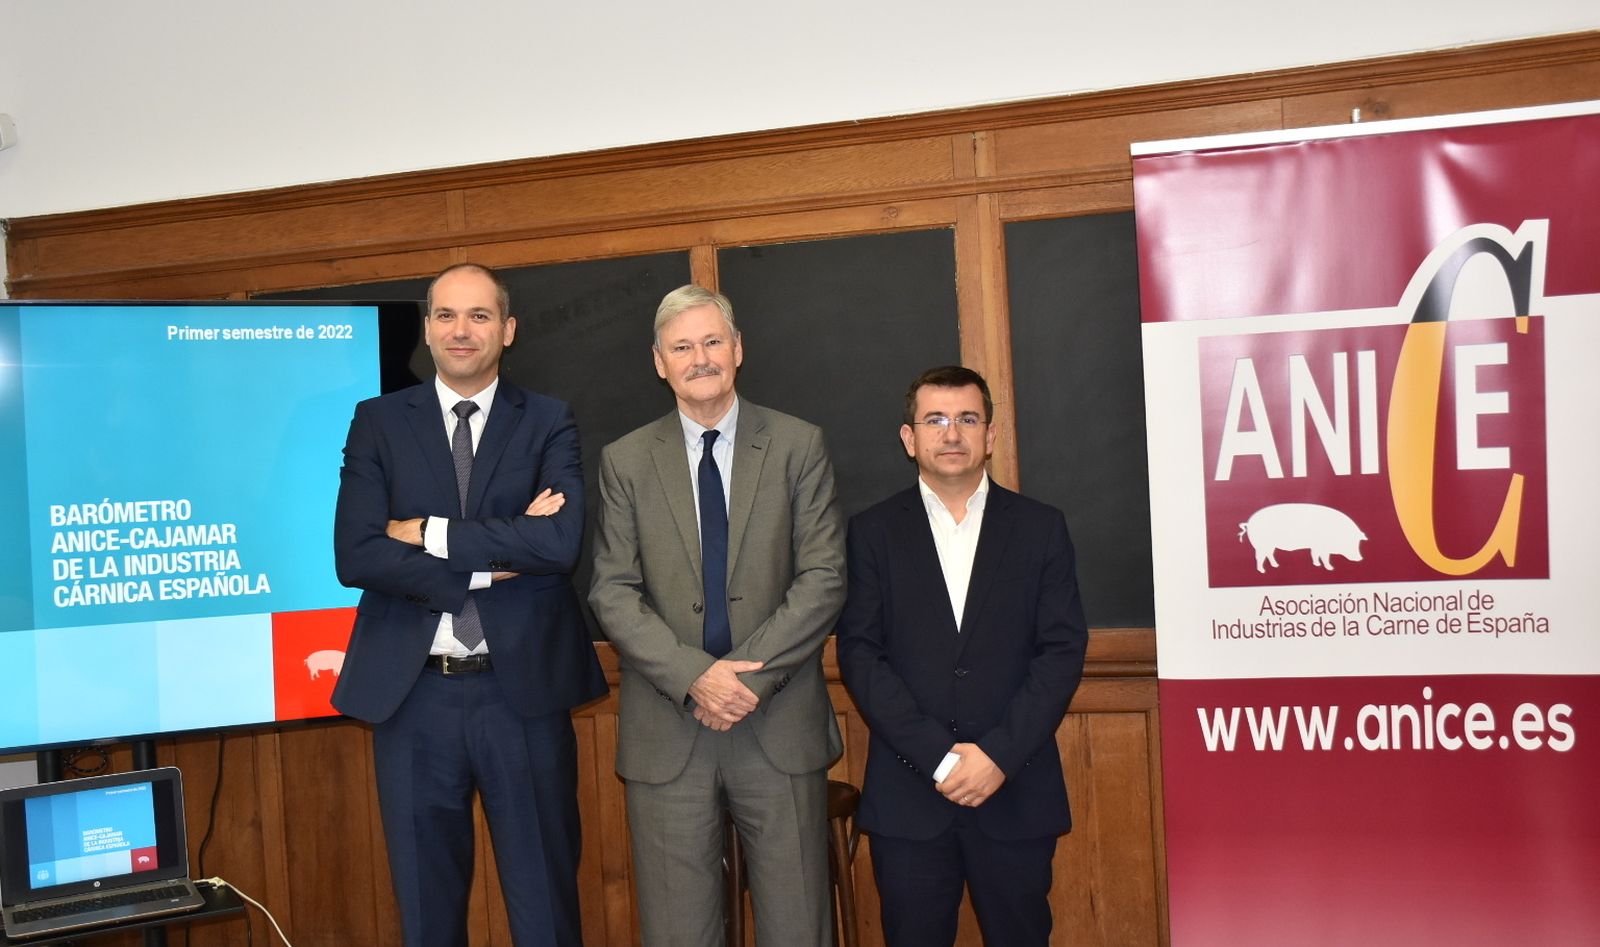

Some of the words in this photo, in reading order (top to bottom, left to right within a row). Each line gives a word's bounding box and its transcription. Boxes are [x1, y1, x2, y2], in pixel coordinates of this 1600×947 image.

[167, 325, 220, 341] Primer
[223, 325, 293, 340] semestre
[296, 325, 315, 340] de
[318, 324, 353, 340] 2022
[1215, 236, 1533, 576] ANICE
[50, 498, 192, 527] BARÓMETRO
[51, 523, 237, 553] ANICE-CAJAMAR
[53, 558, 83, 581] DE
[89, 556, 119, 578] LA
[124, 549, 241, 576] INDUSTRIA
[53, 580, 154, 608] CÁRNICA
[159, 571, 271, 600] ESPAÑOLA
[1259, 592, 1368, 616] Asociación
[1373, 590, 1463, 613] Nacional
[1467, 589, 1494, 610] de
[1212, 617, 1307, 640] Industrias
[1311, 617, 1336, 638] de
[1342, 616, 1359, 636] la
[1366, 614, 1429, 636] Carne
[1436, 613, 1462, 634] de
[1467, 612, 1550, 638] España
[1196, 686, 1576, 752] www.anice.es
